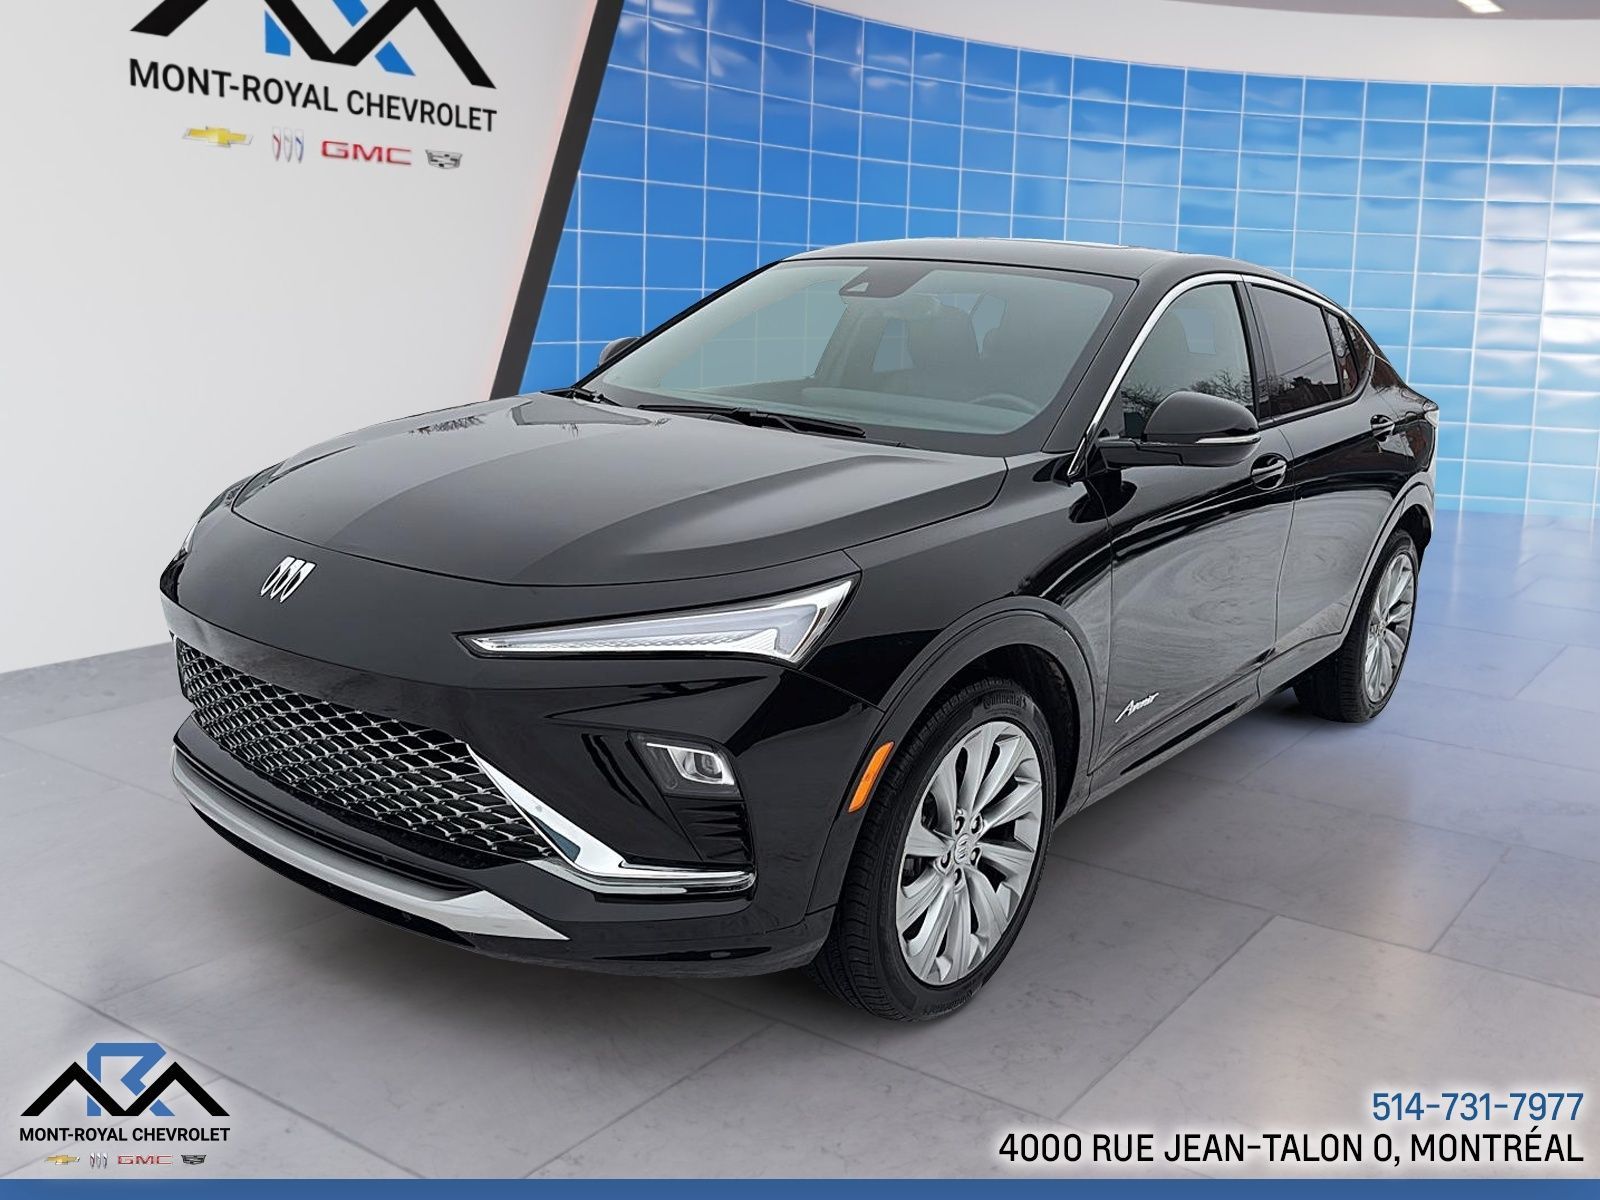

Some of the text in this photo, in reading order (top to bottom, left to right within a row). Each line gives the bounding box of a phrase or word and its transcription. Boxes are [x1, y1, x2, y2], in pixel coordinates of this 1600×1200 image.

[129, 58, 498, 132] MONT-ROYAL CHEVROLET
[320, 140, 412, 166] GMC
